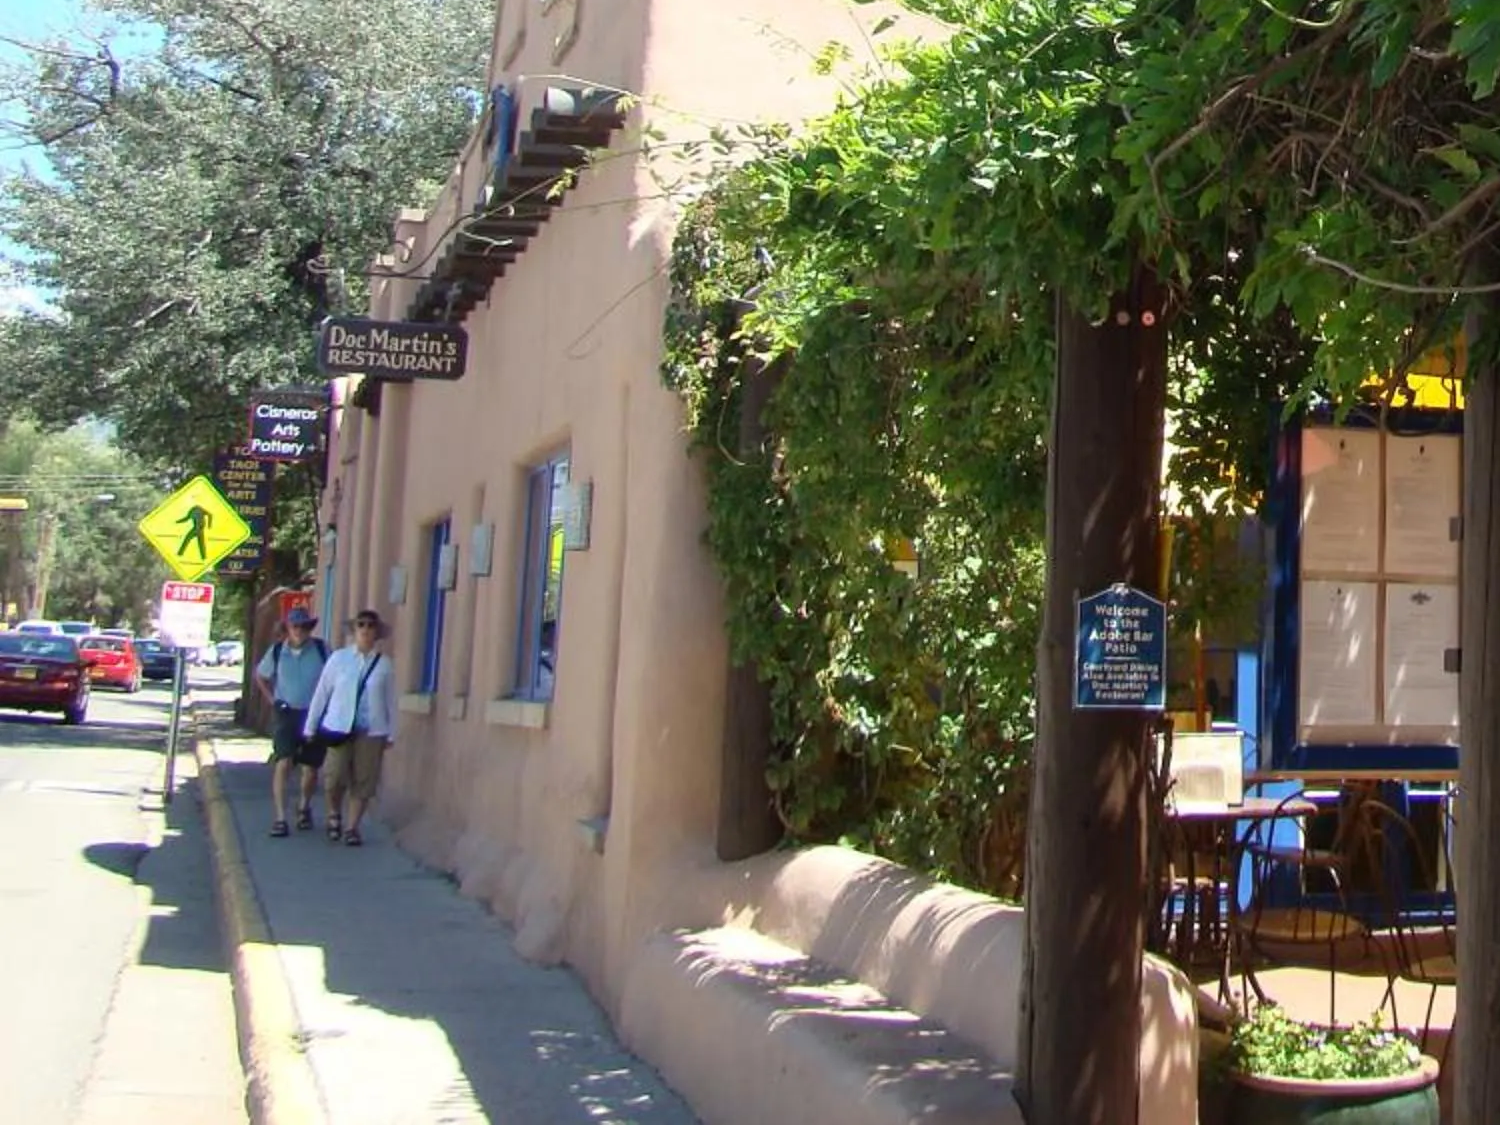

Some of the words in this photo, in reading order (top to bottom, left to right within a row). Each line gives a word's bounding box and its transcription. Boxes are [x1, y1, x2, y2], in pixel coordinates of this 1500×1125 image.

[329, 326, 366, 349] Doc
[369, 328, 457, 356] Martin's
[328, 349, 457, 373] RESTAURANT
[256, 404, 318, 420] Cisneros
[271, 422, 300, 436] Arts
[251, 438, 304, 456] Pottery
[219, 470, 266, 481] CENTER
[172, 586, 205, 601] STOP
[1095, 604, 1149, 616] Welcome
[1103, 618, 1117, 628] to
[1120, 617, 1140, 628] the
[1089, 628, 1131, 642] Adobe
[1133, 630, 1153, 642] Bar
[1105, 642, 1137, 654] Patio
